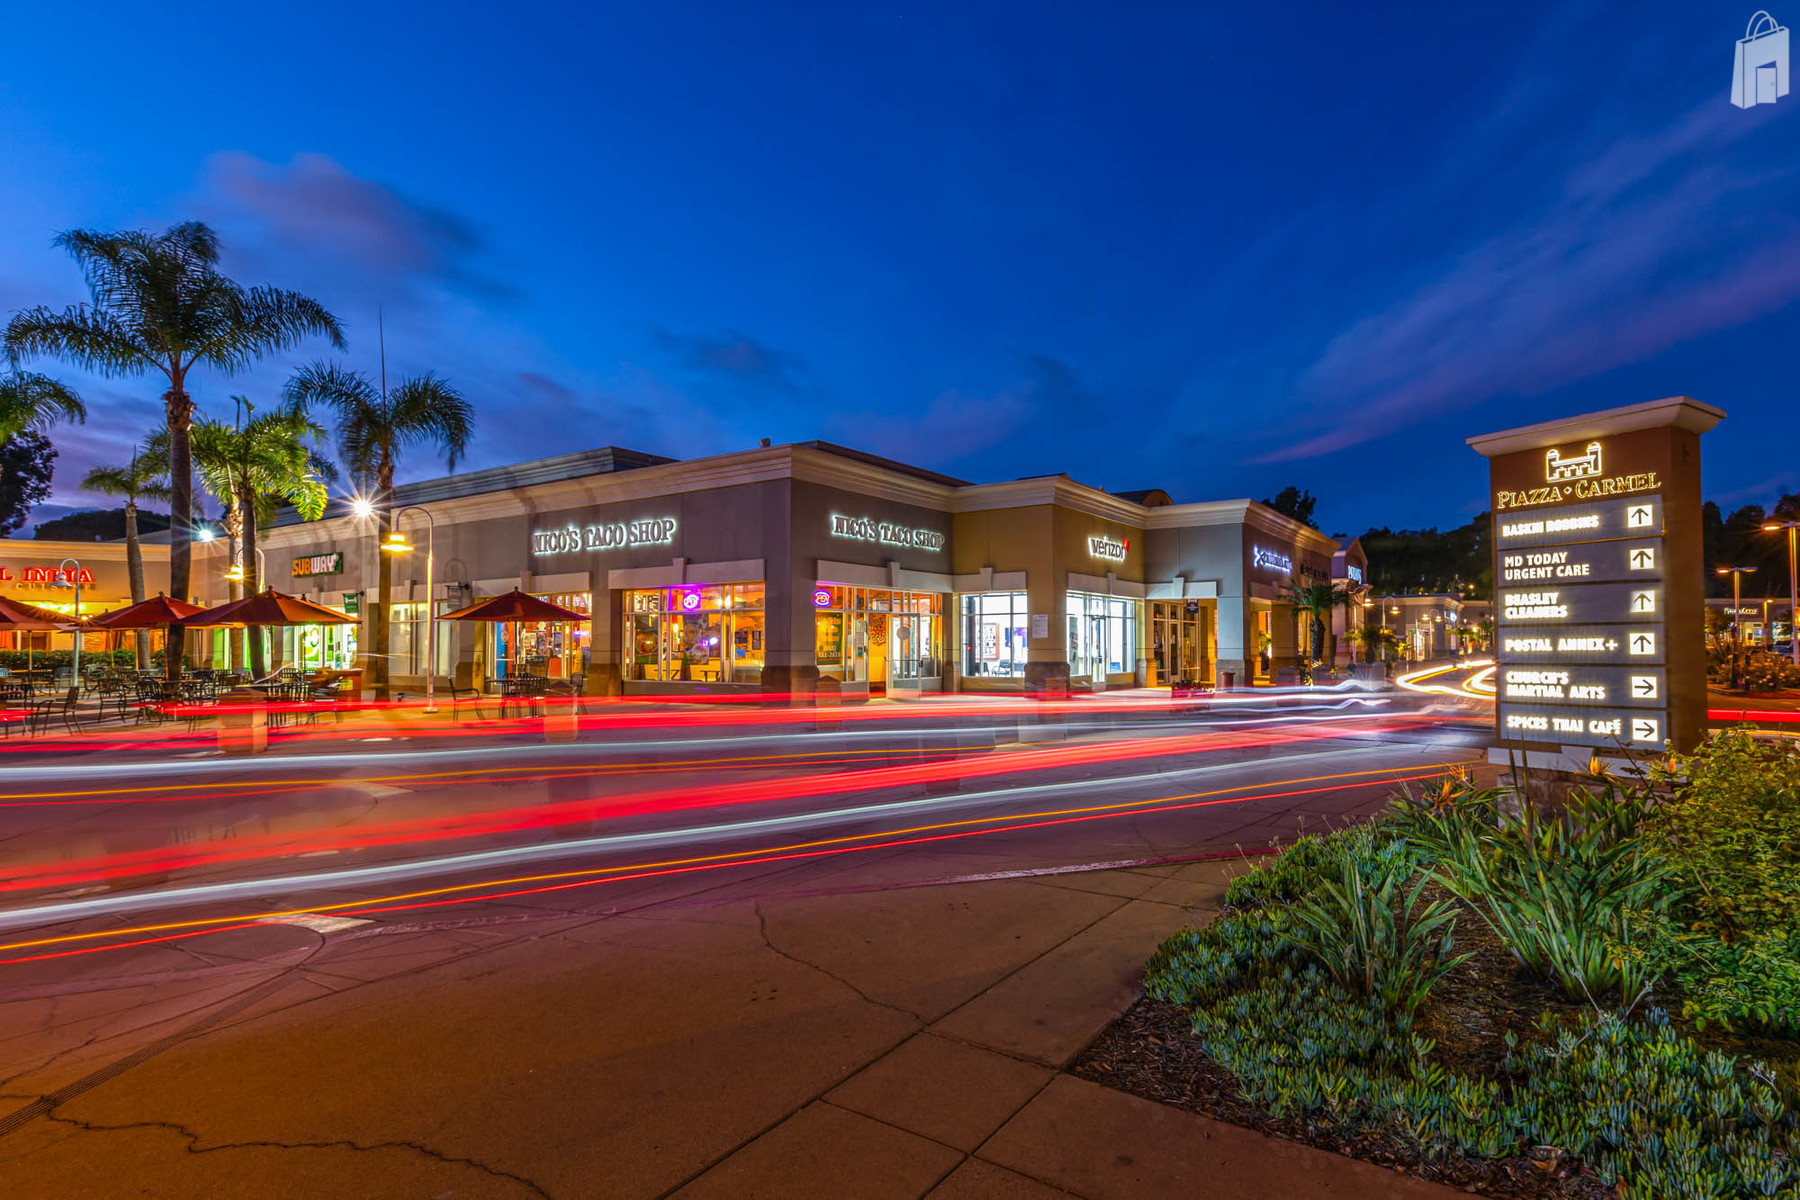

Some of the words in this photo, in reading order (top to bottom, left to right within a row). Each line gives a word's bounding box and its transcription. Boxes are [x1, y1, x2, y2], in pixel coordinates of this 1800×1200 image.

[1497, 486, 1563, 509] PIAZZA
[1575, 473, 1662, 498] CARMEL
[832, 515, 878, 540] NICO'S
[880, 523, 912, 546] TACO
[914, 529, 945, 550] SHOP
[1502, 521, 1545, 537] BASKIN
[1546, 515, 1599, 532] ROBBINS
[533, 526, 579, 554] NICO'S
[582, 524, 625, 549] TACO
[628, 518, 675, 544] SHOP
[1089, 536, 1127, 560] verizon
[291, 553, 339, 576] SUBWAY
[1504, 555, 1523, 567] MD
[1526, 551, 1568, 566] TODAY
[1504, 567, 1553, 580] URGENT
[1556, 564, 1590, 577] CARE
[1504, 592, 1559, 606] BEASLEY
[1504, 605, 1568, 619] CLEANERS
[1504, 638, 1553, 652] POSTAL
[1506, 671, 1569, 685] CHURCH'S
[1506, 684, 1564, 698] MARTIAL
[1569, 685, 1606, 699] ARTS
[1507, 715, 1548, 730] SPICES
[1552, 718, 1584, 732] THAI
